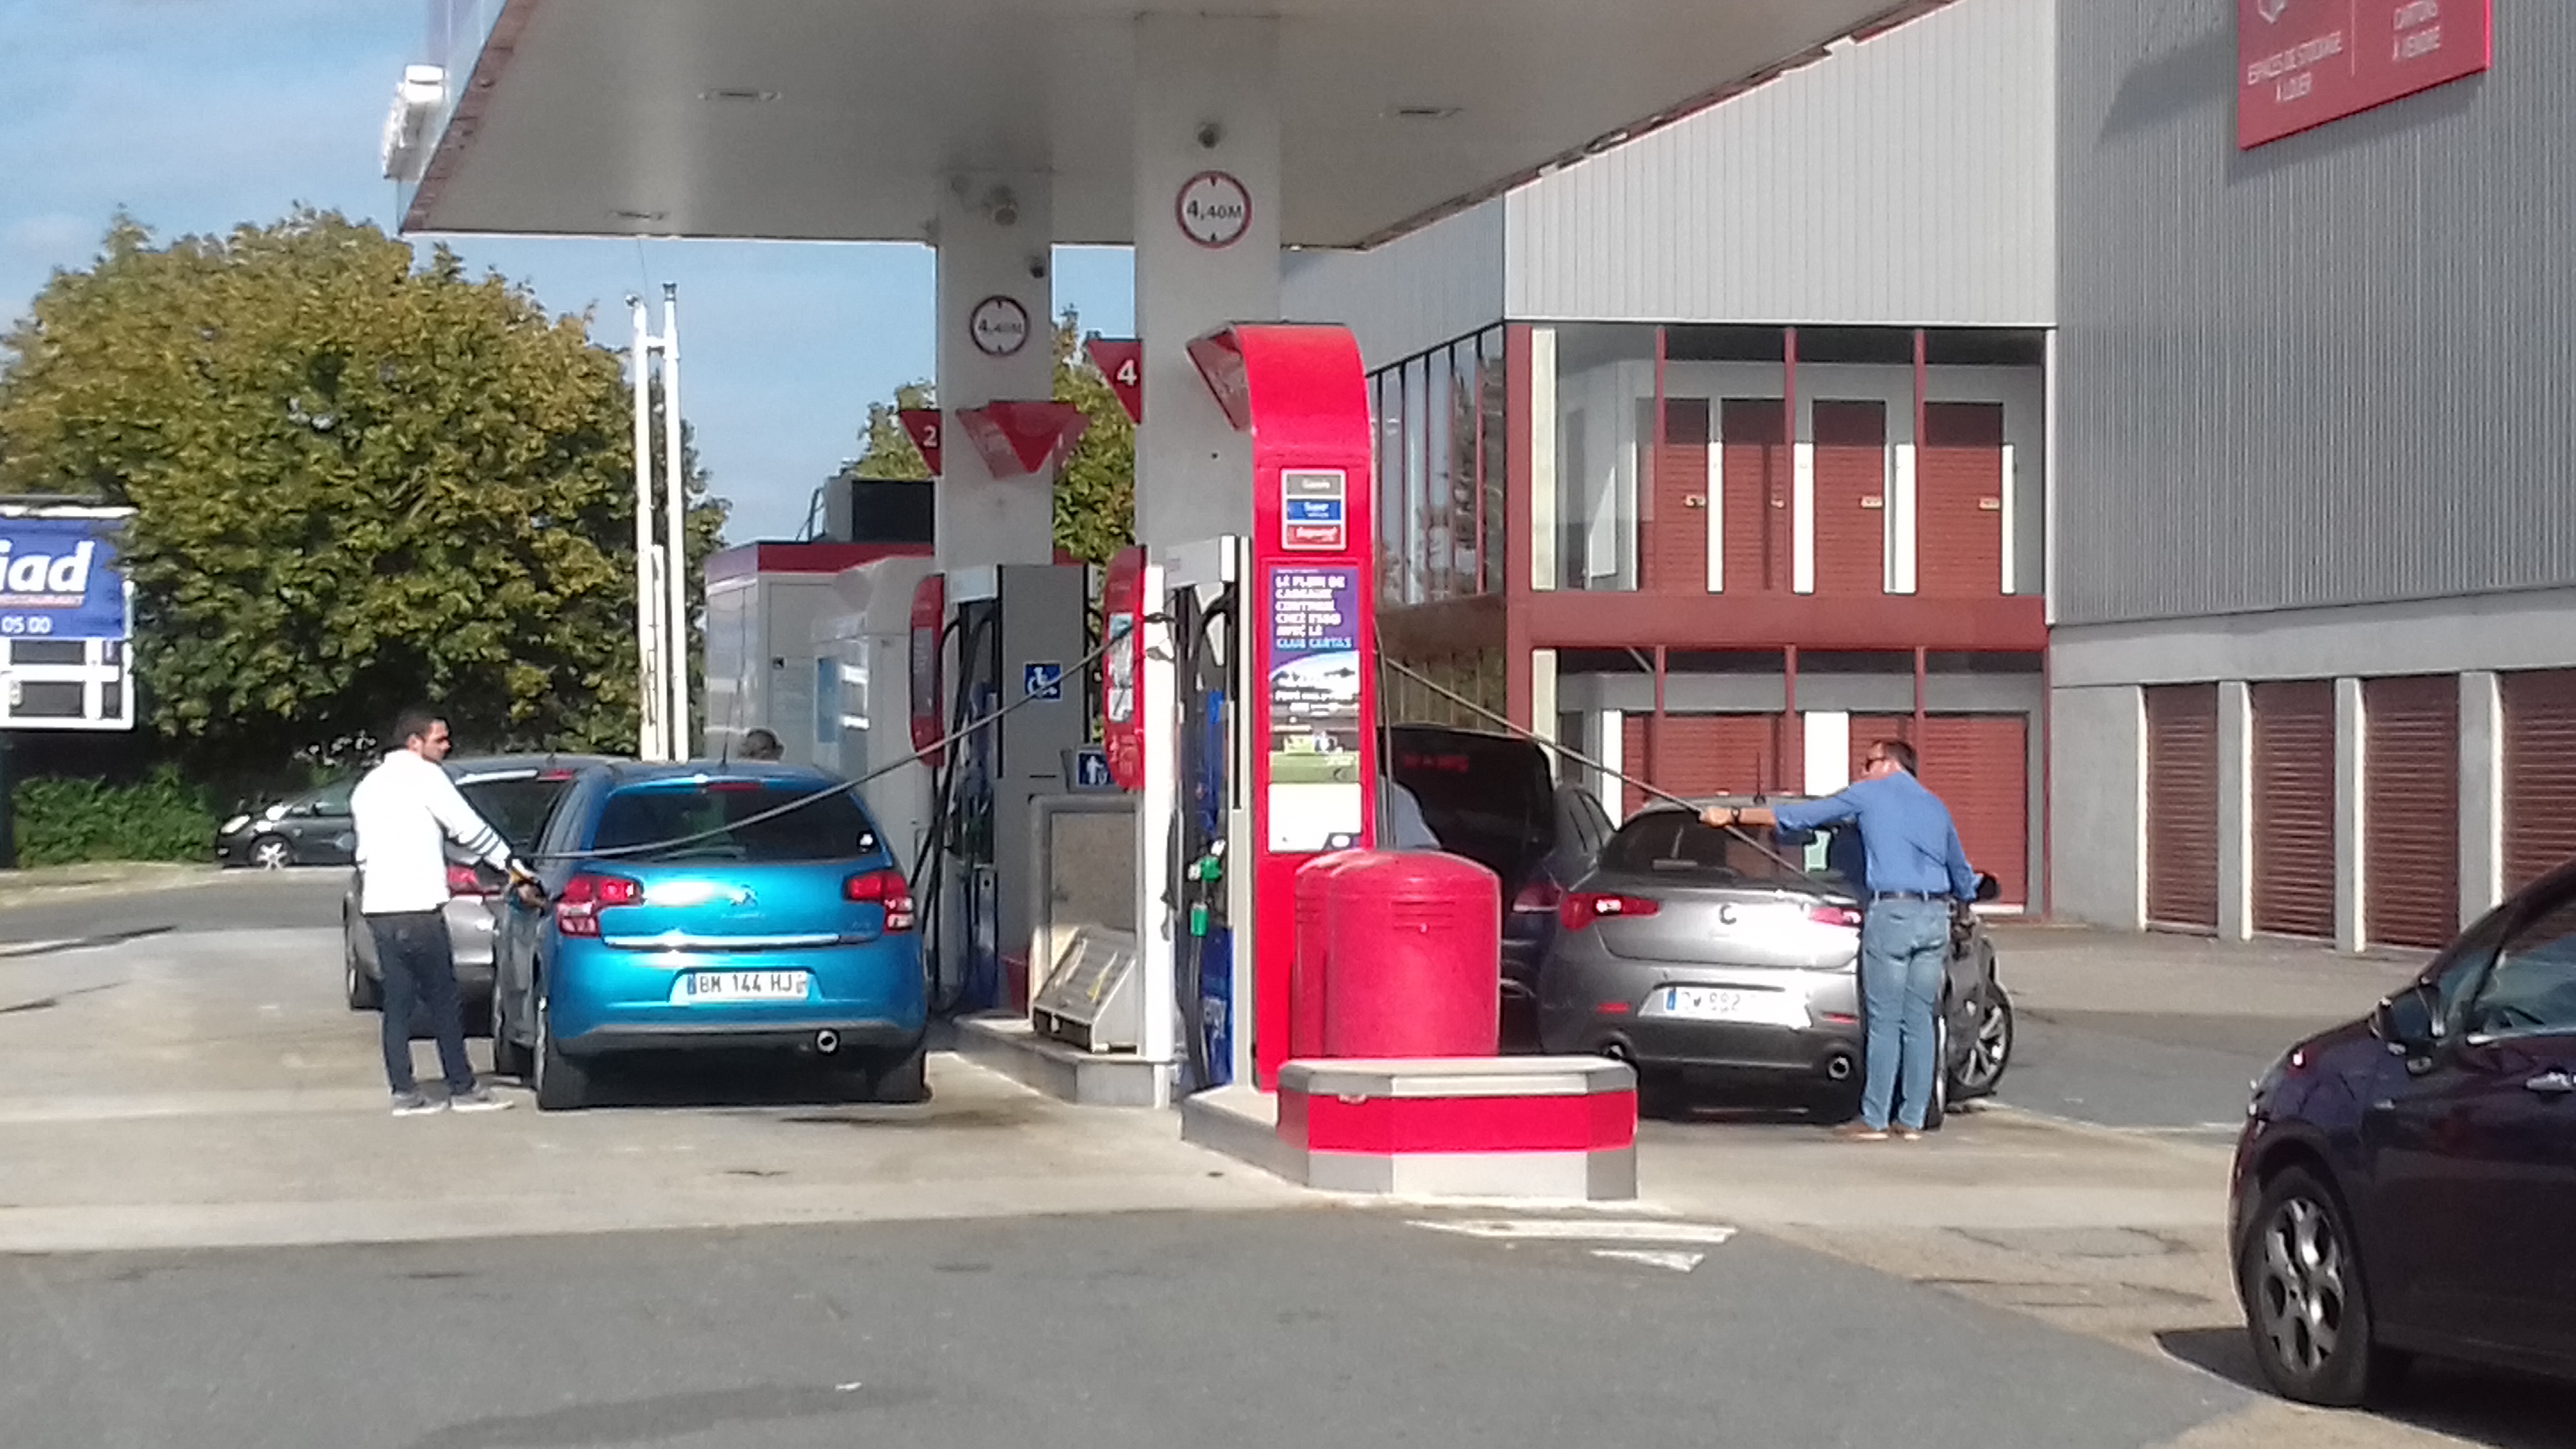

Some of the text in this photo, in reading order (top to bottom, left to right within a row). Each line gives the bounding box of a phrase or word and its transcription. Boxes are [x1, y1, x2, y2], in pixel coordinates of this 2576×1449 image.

[1117, 359, 1137, 386] 4
[923, 425, 938, 447] 2
[2, 616, 52, 634] 05 00
[700, 975, 721, 993] BM
[733, 974, 762, 992] 144
[770, 974, 792, 992] HJ
